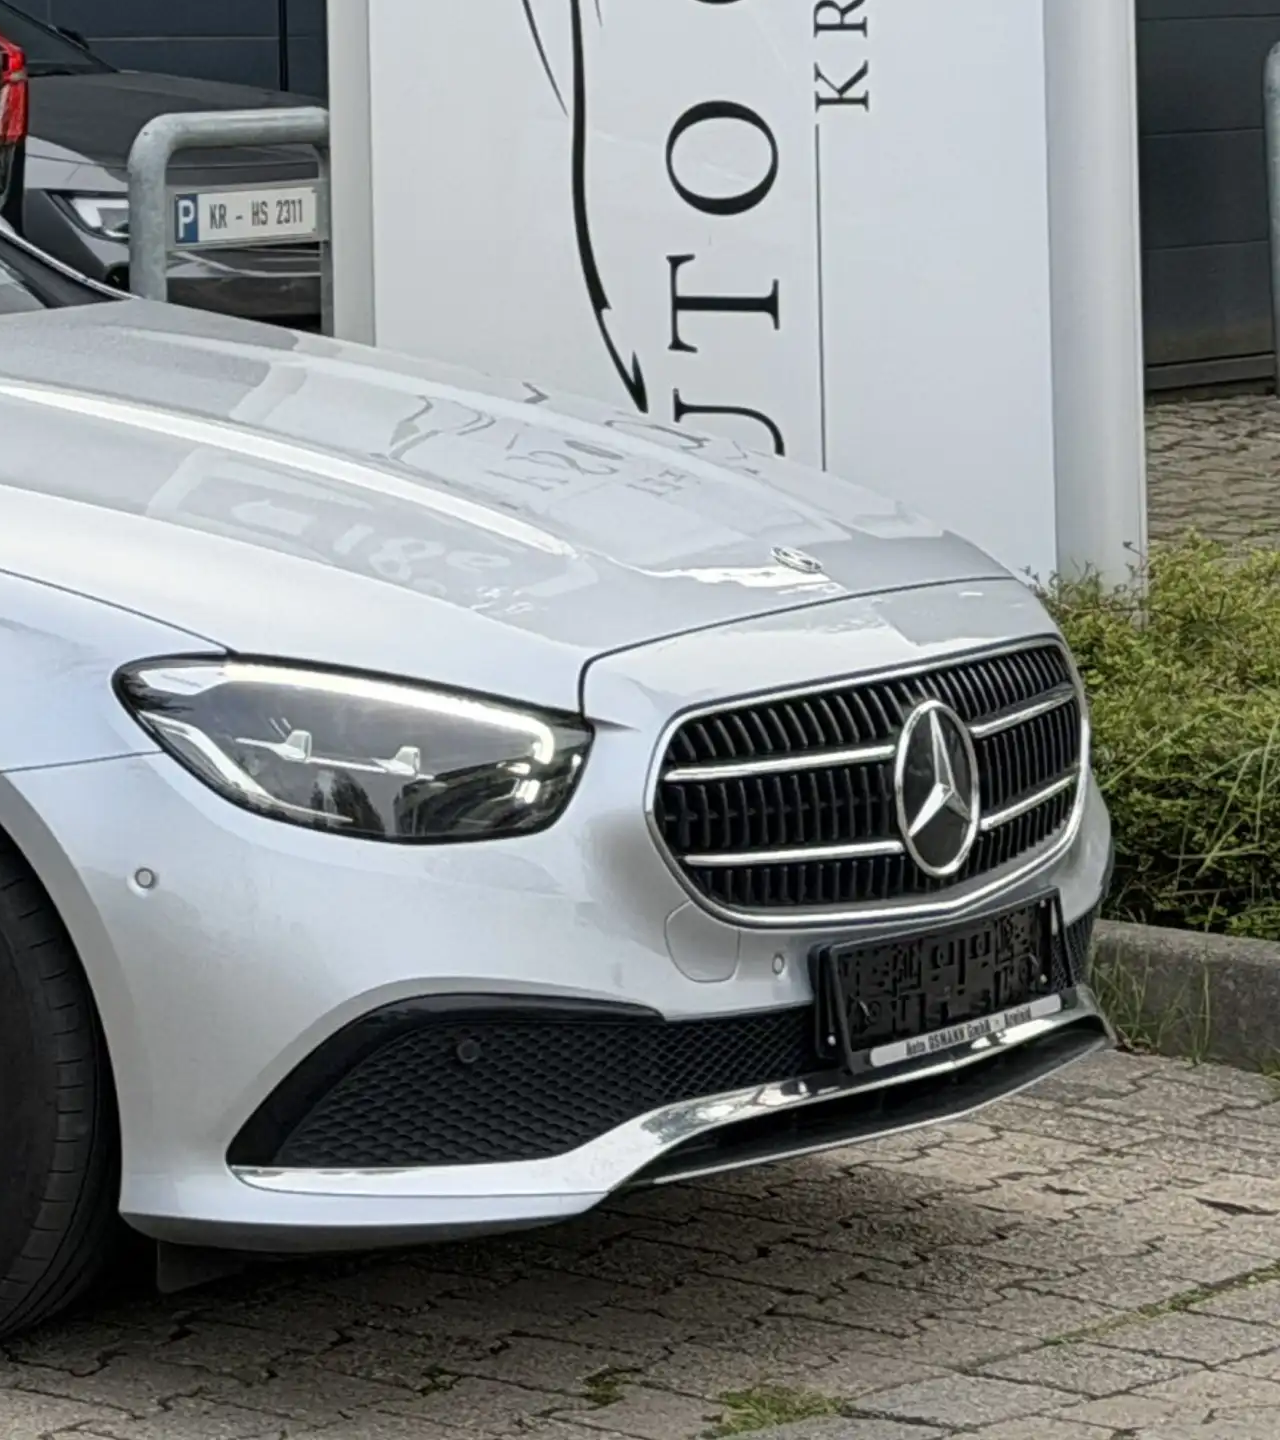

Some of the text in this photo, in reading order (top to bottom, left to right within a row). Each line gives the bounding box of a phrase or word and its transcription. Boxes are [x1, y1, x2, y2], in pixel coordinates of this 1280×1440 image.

[209, 203, 228, 229] KR
[251, 201, 269, 226] HS
[275, 198, 303, 225] 2311
